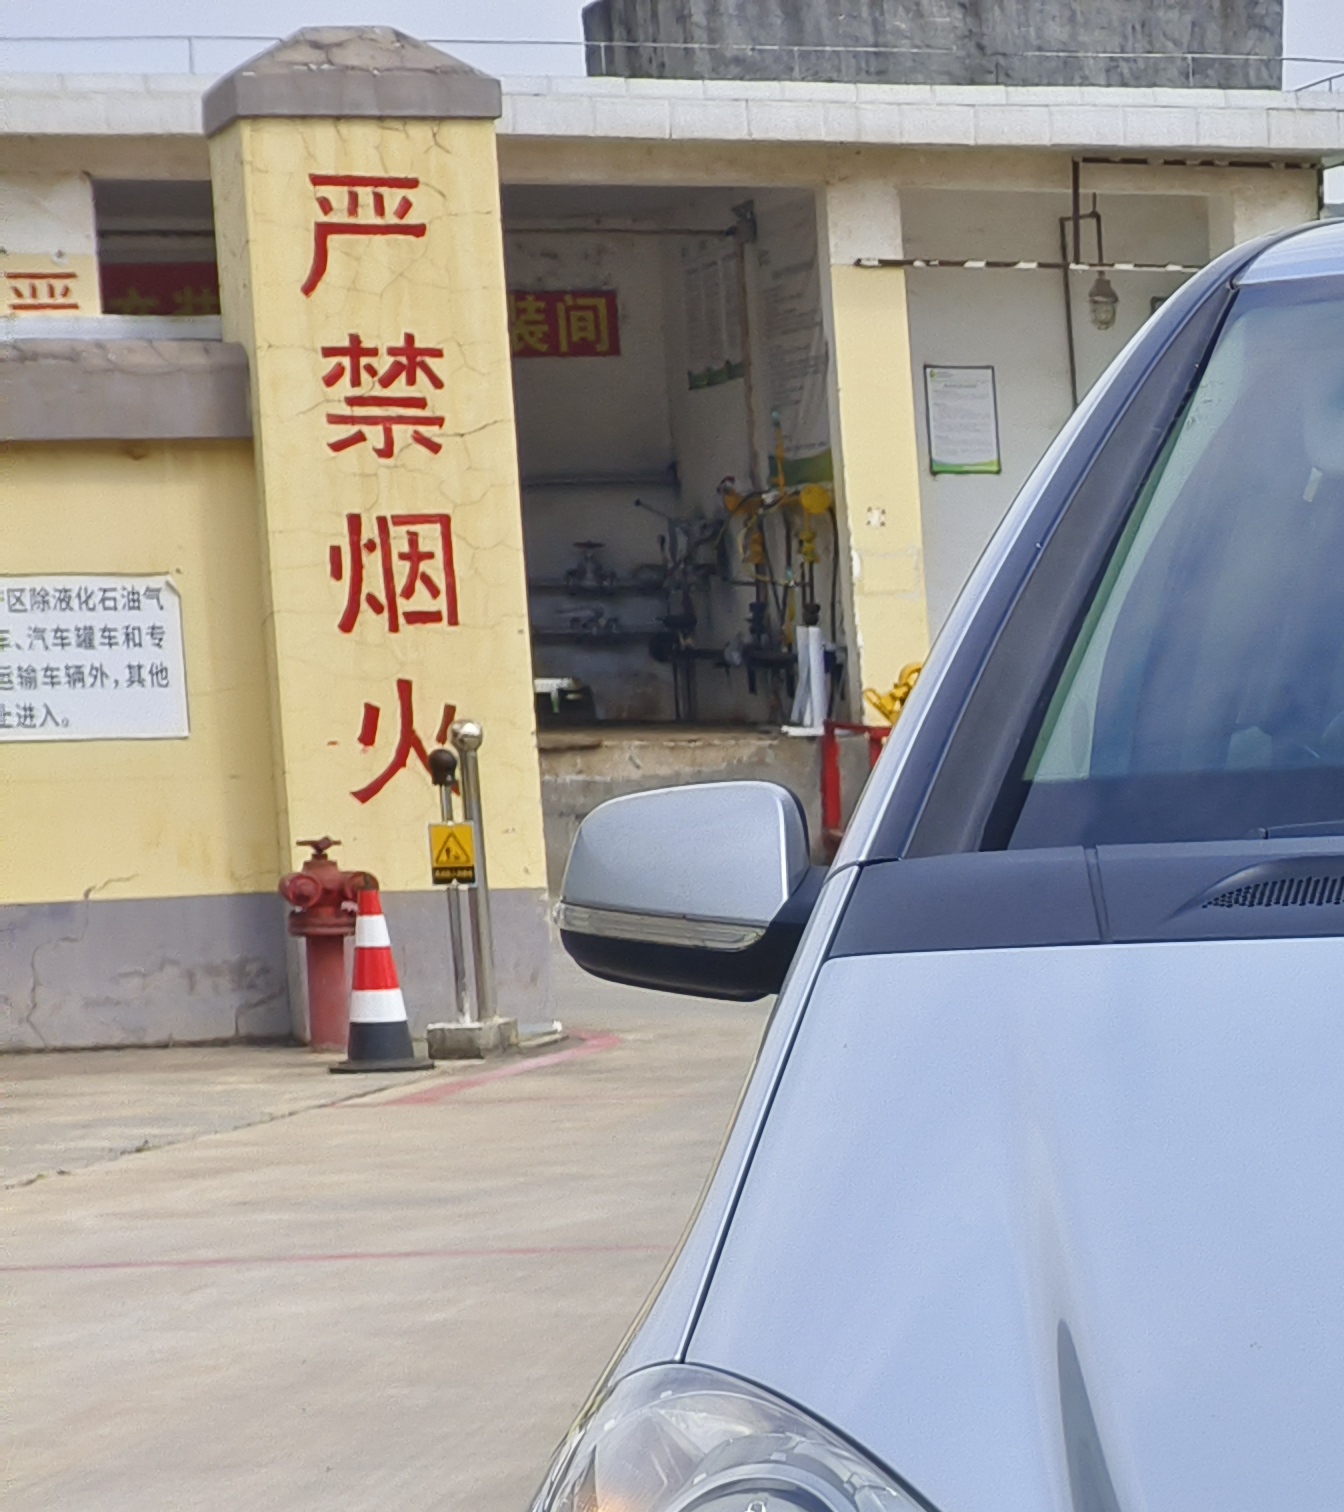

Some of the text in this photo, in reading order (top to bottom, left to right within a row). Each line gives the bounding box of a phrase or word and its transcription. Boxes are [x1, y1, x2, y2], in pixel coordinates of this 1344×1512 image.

[0, 585, 165, 613] 区除液化石油气
[300, 173, 460, 805] 严禁烟火
